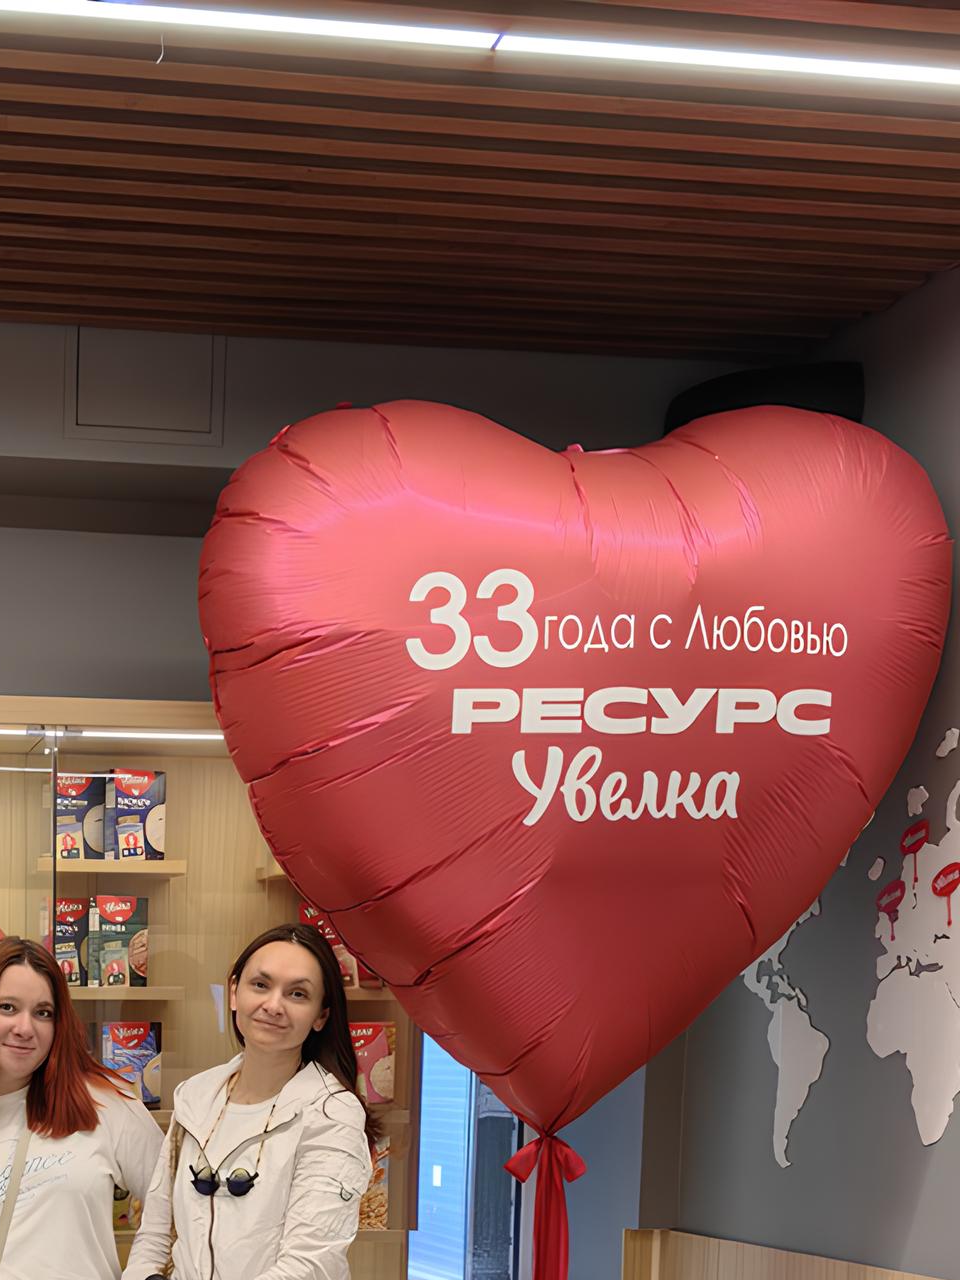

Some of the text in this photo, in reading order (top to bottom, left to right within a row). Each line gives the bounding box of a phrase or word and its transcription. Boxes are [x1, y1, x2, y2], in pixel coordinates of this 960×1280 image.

[406, 568, 849, 671] 33 года с Любовью
[451, 686, 833, 736] РЕСУРС
[512, 746, 741, 827] Увелка
